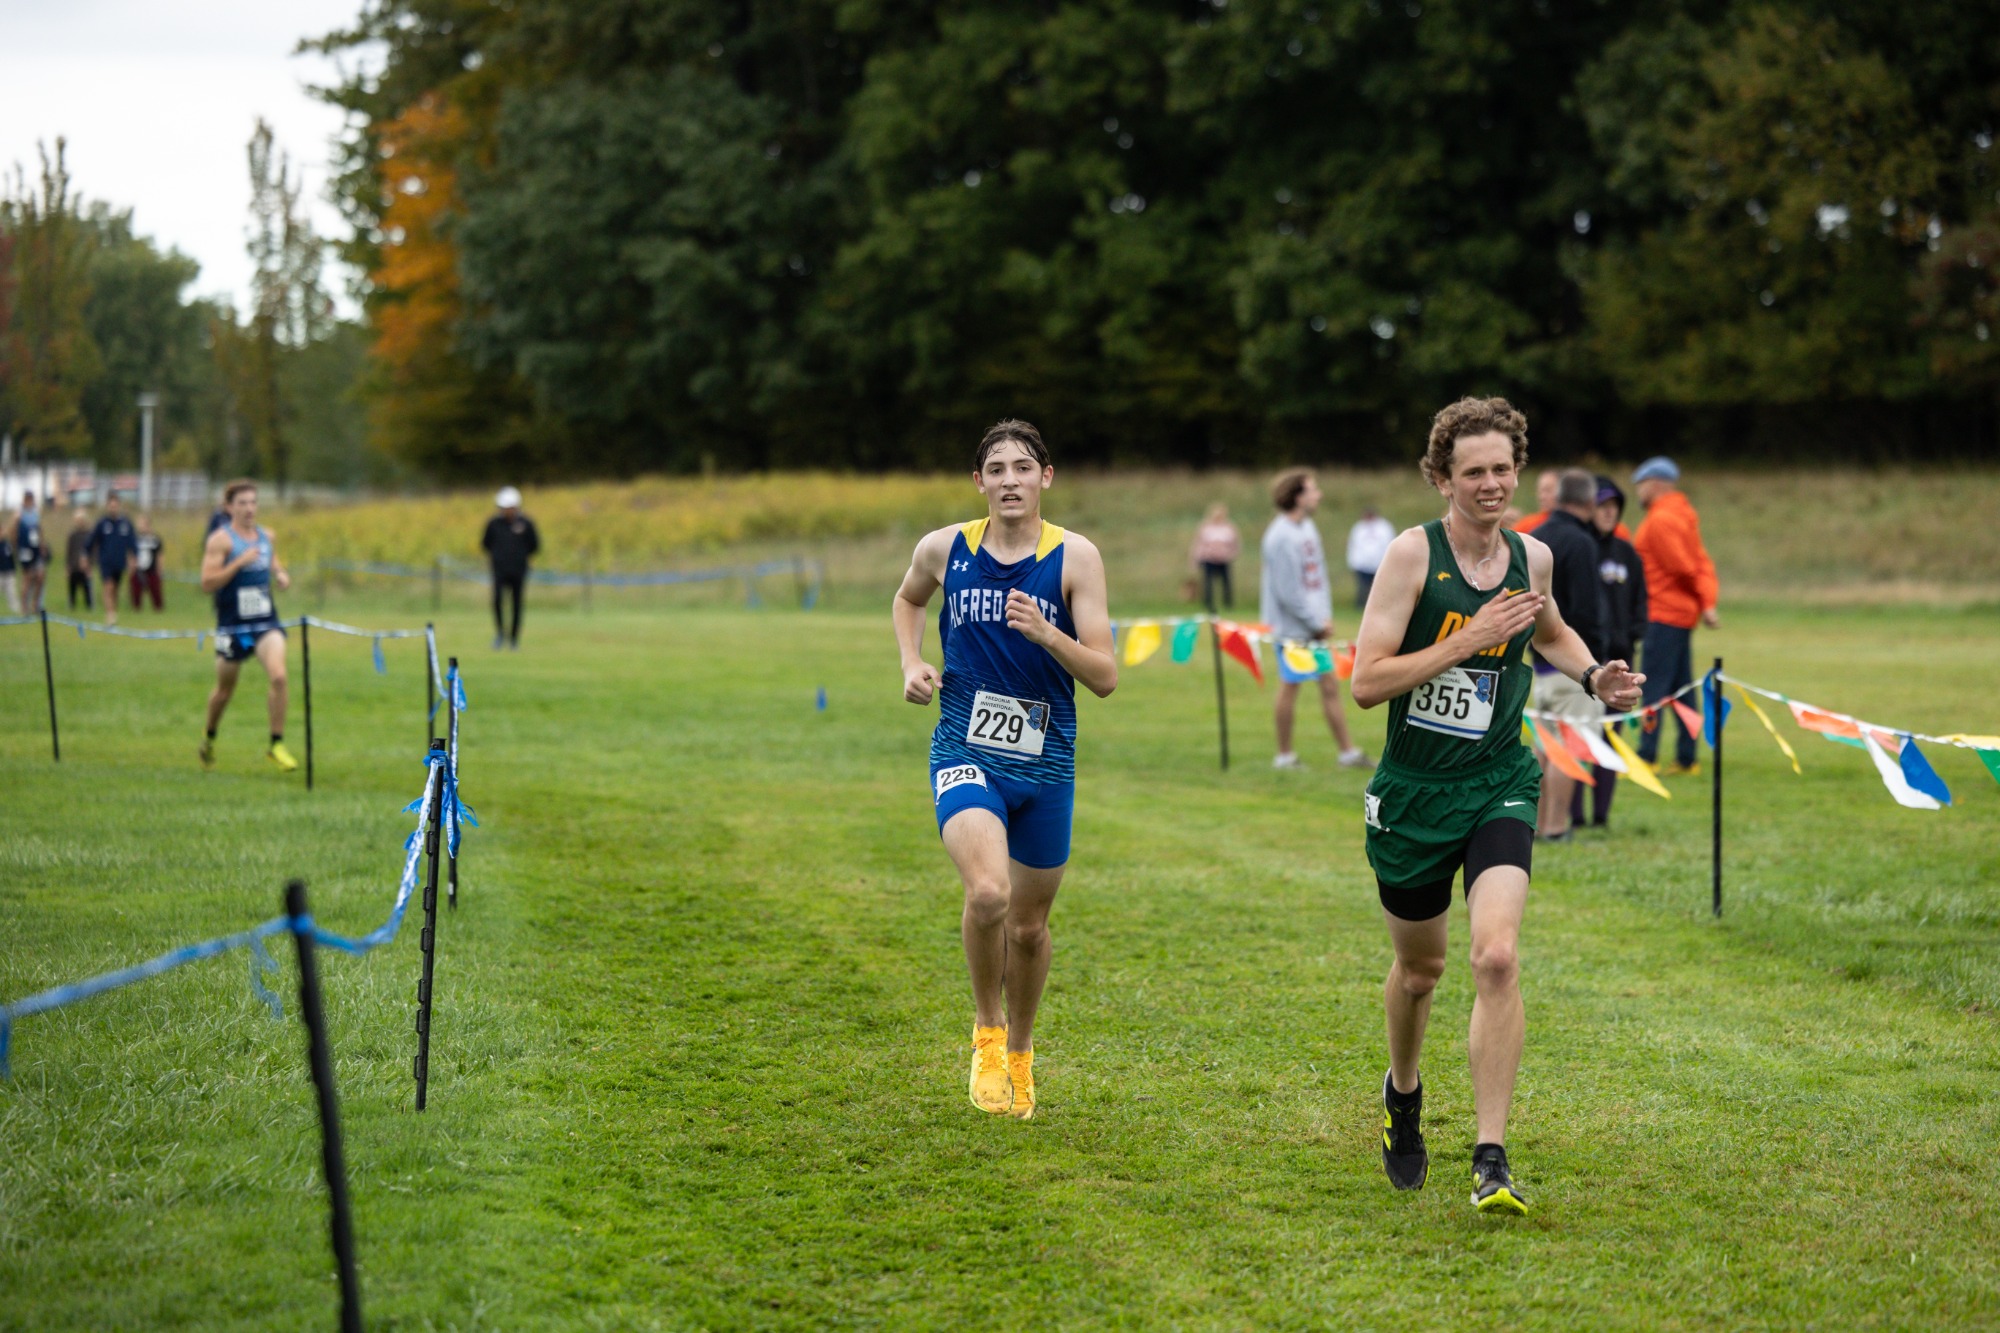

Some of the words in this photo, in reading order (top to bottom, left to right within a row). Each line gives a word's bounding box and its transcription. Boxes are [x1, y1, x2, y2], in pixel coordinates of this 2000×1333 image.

[948, 588, 1003, 630] ALFRED
[980, 701, 1014, 711] INVITATIONAL
[985, 695, 1011, 704] FREDONIA
[1415, 681, 1472, 720] 355
[972, 708, 1024, 744] 229
[940, 767, 977, 788] 229
